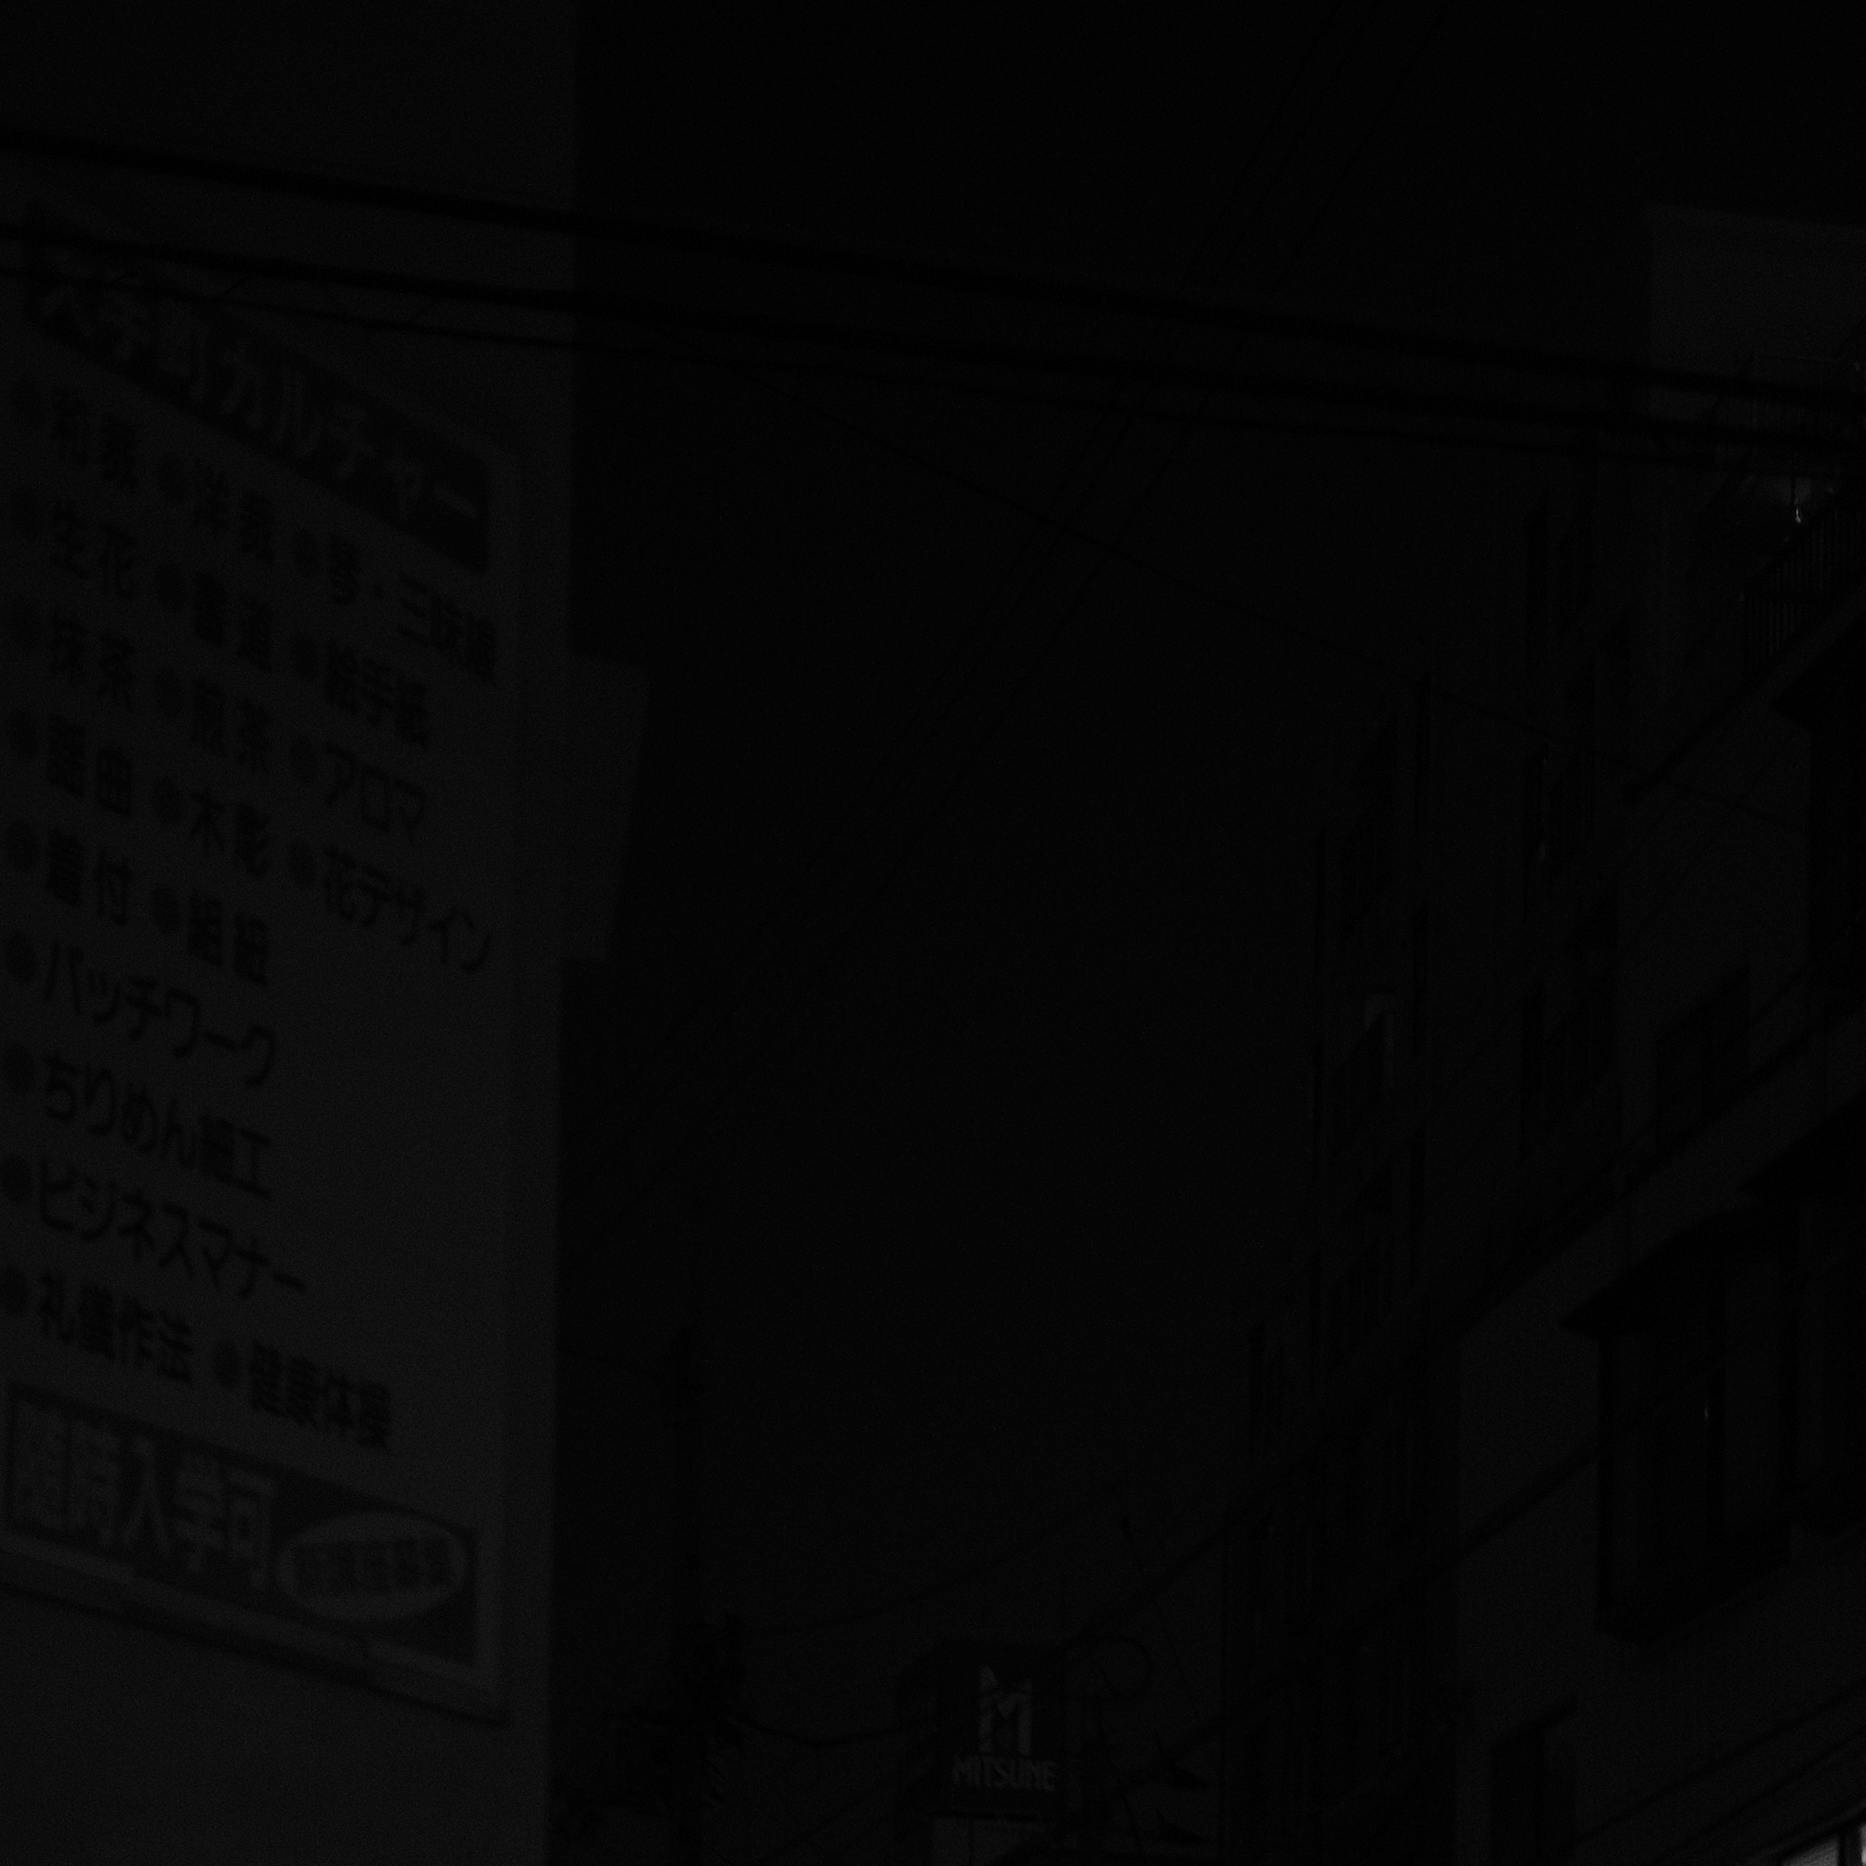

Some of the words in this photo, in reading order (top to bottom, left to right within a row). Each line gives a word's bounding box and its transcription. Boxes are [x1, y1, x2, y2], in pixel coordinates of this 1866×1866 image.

[324, 740, 428, 845] アロマ
[323, 843, 493, 972] 花デザイン
[44, 938, 276, 1089] パッチワーク
[44, 1050, 272, 1200] ちりめん細工
[40, 1157, 307, 1298] ビジネスマナー
